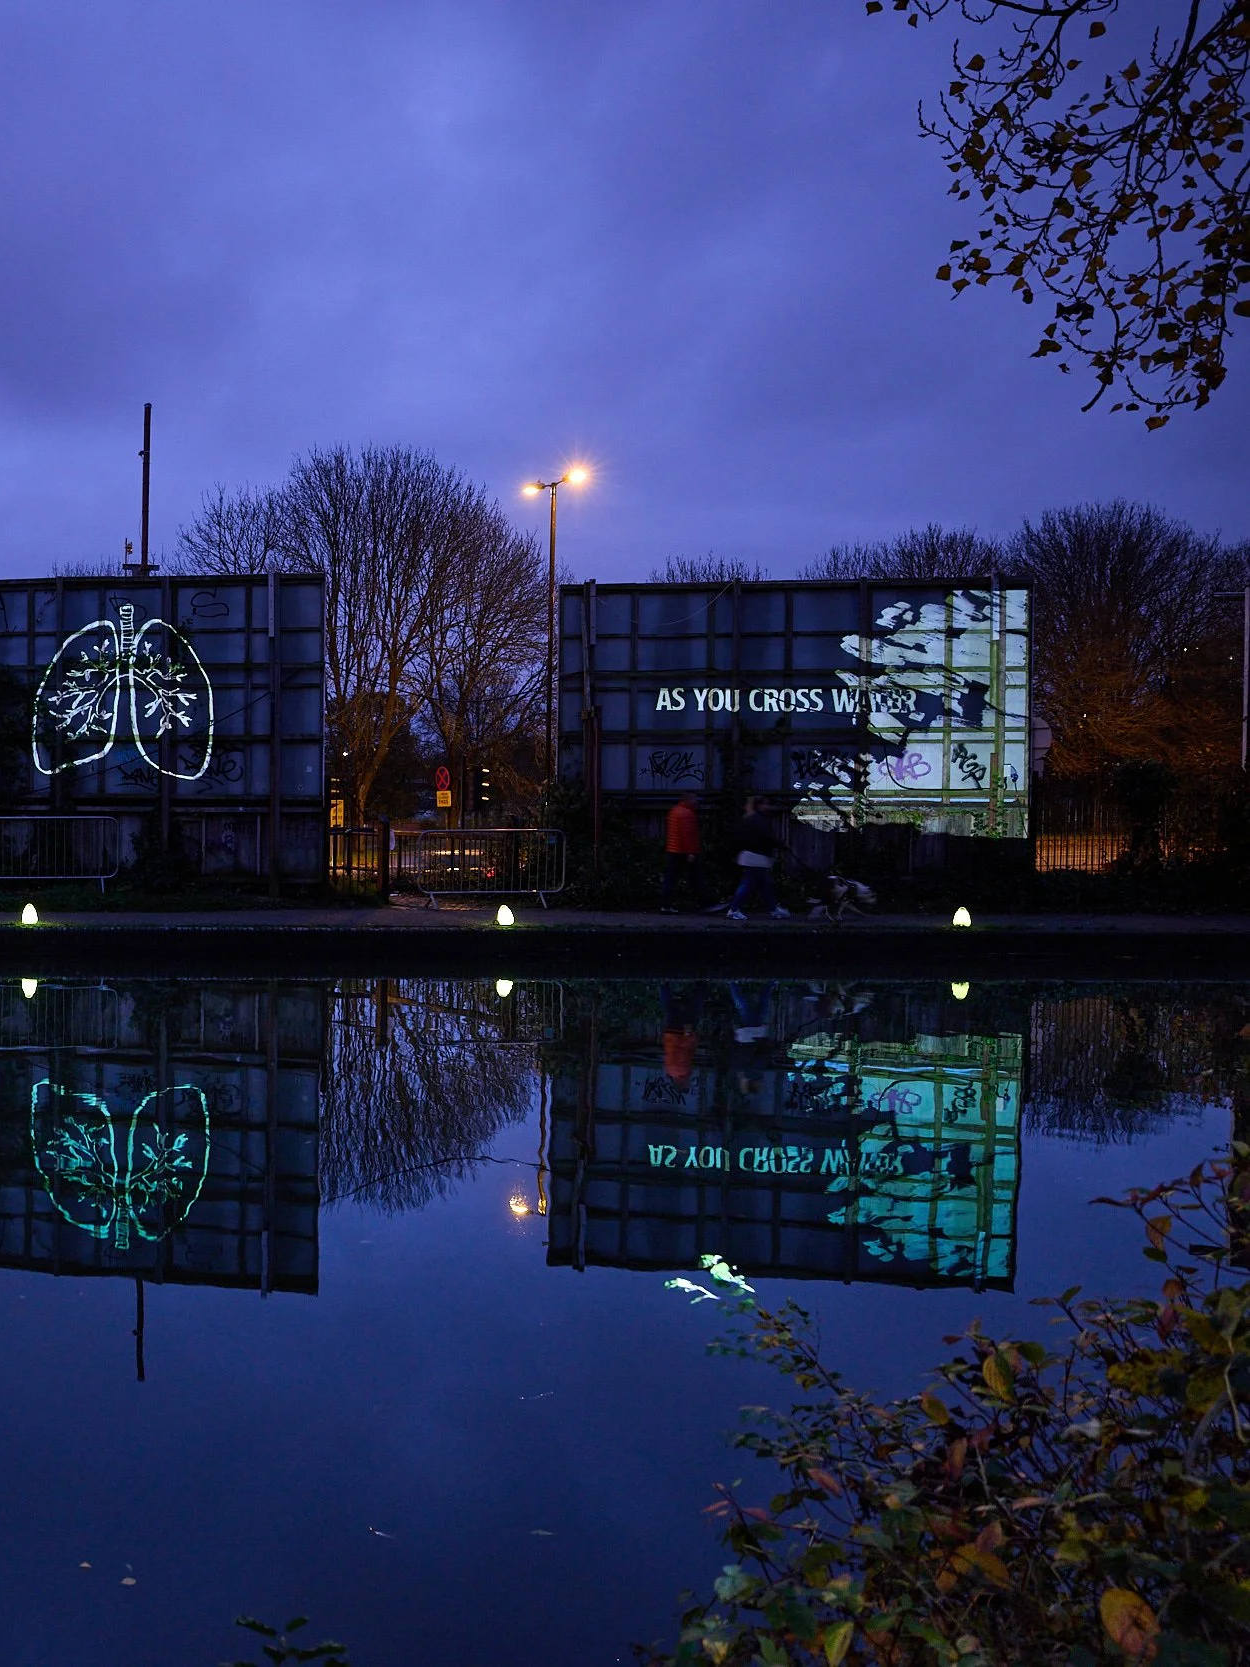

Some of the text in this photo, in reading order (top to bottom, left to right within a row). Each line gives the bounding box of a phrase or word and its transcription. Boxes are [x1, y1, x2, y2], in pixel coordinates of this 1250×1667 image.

[655, 687, 686, 712] AS
[692, 688, 740, 713] YOU
[748, 688, 824, 713] CROSS
